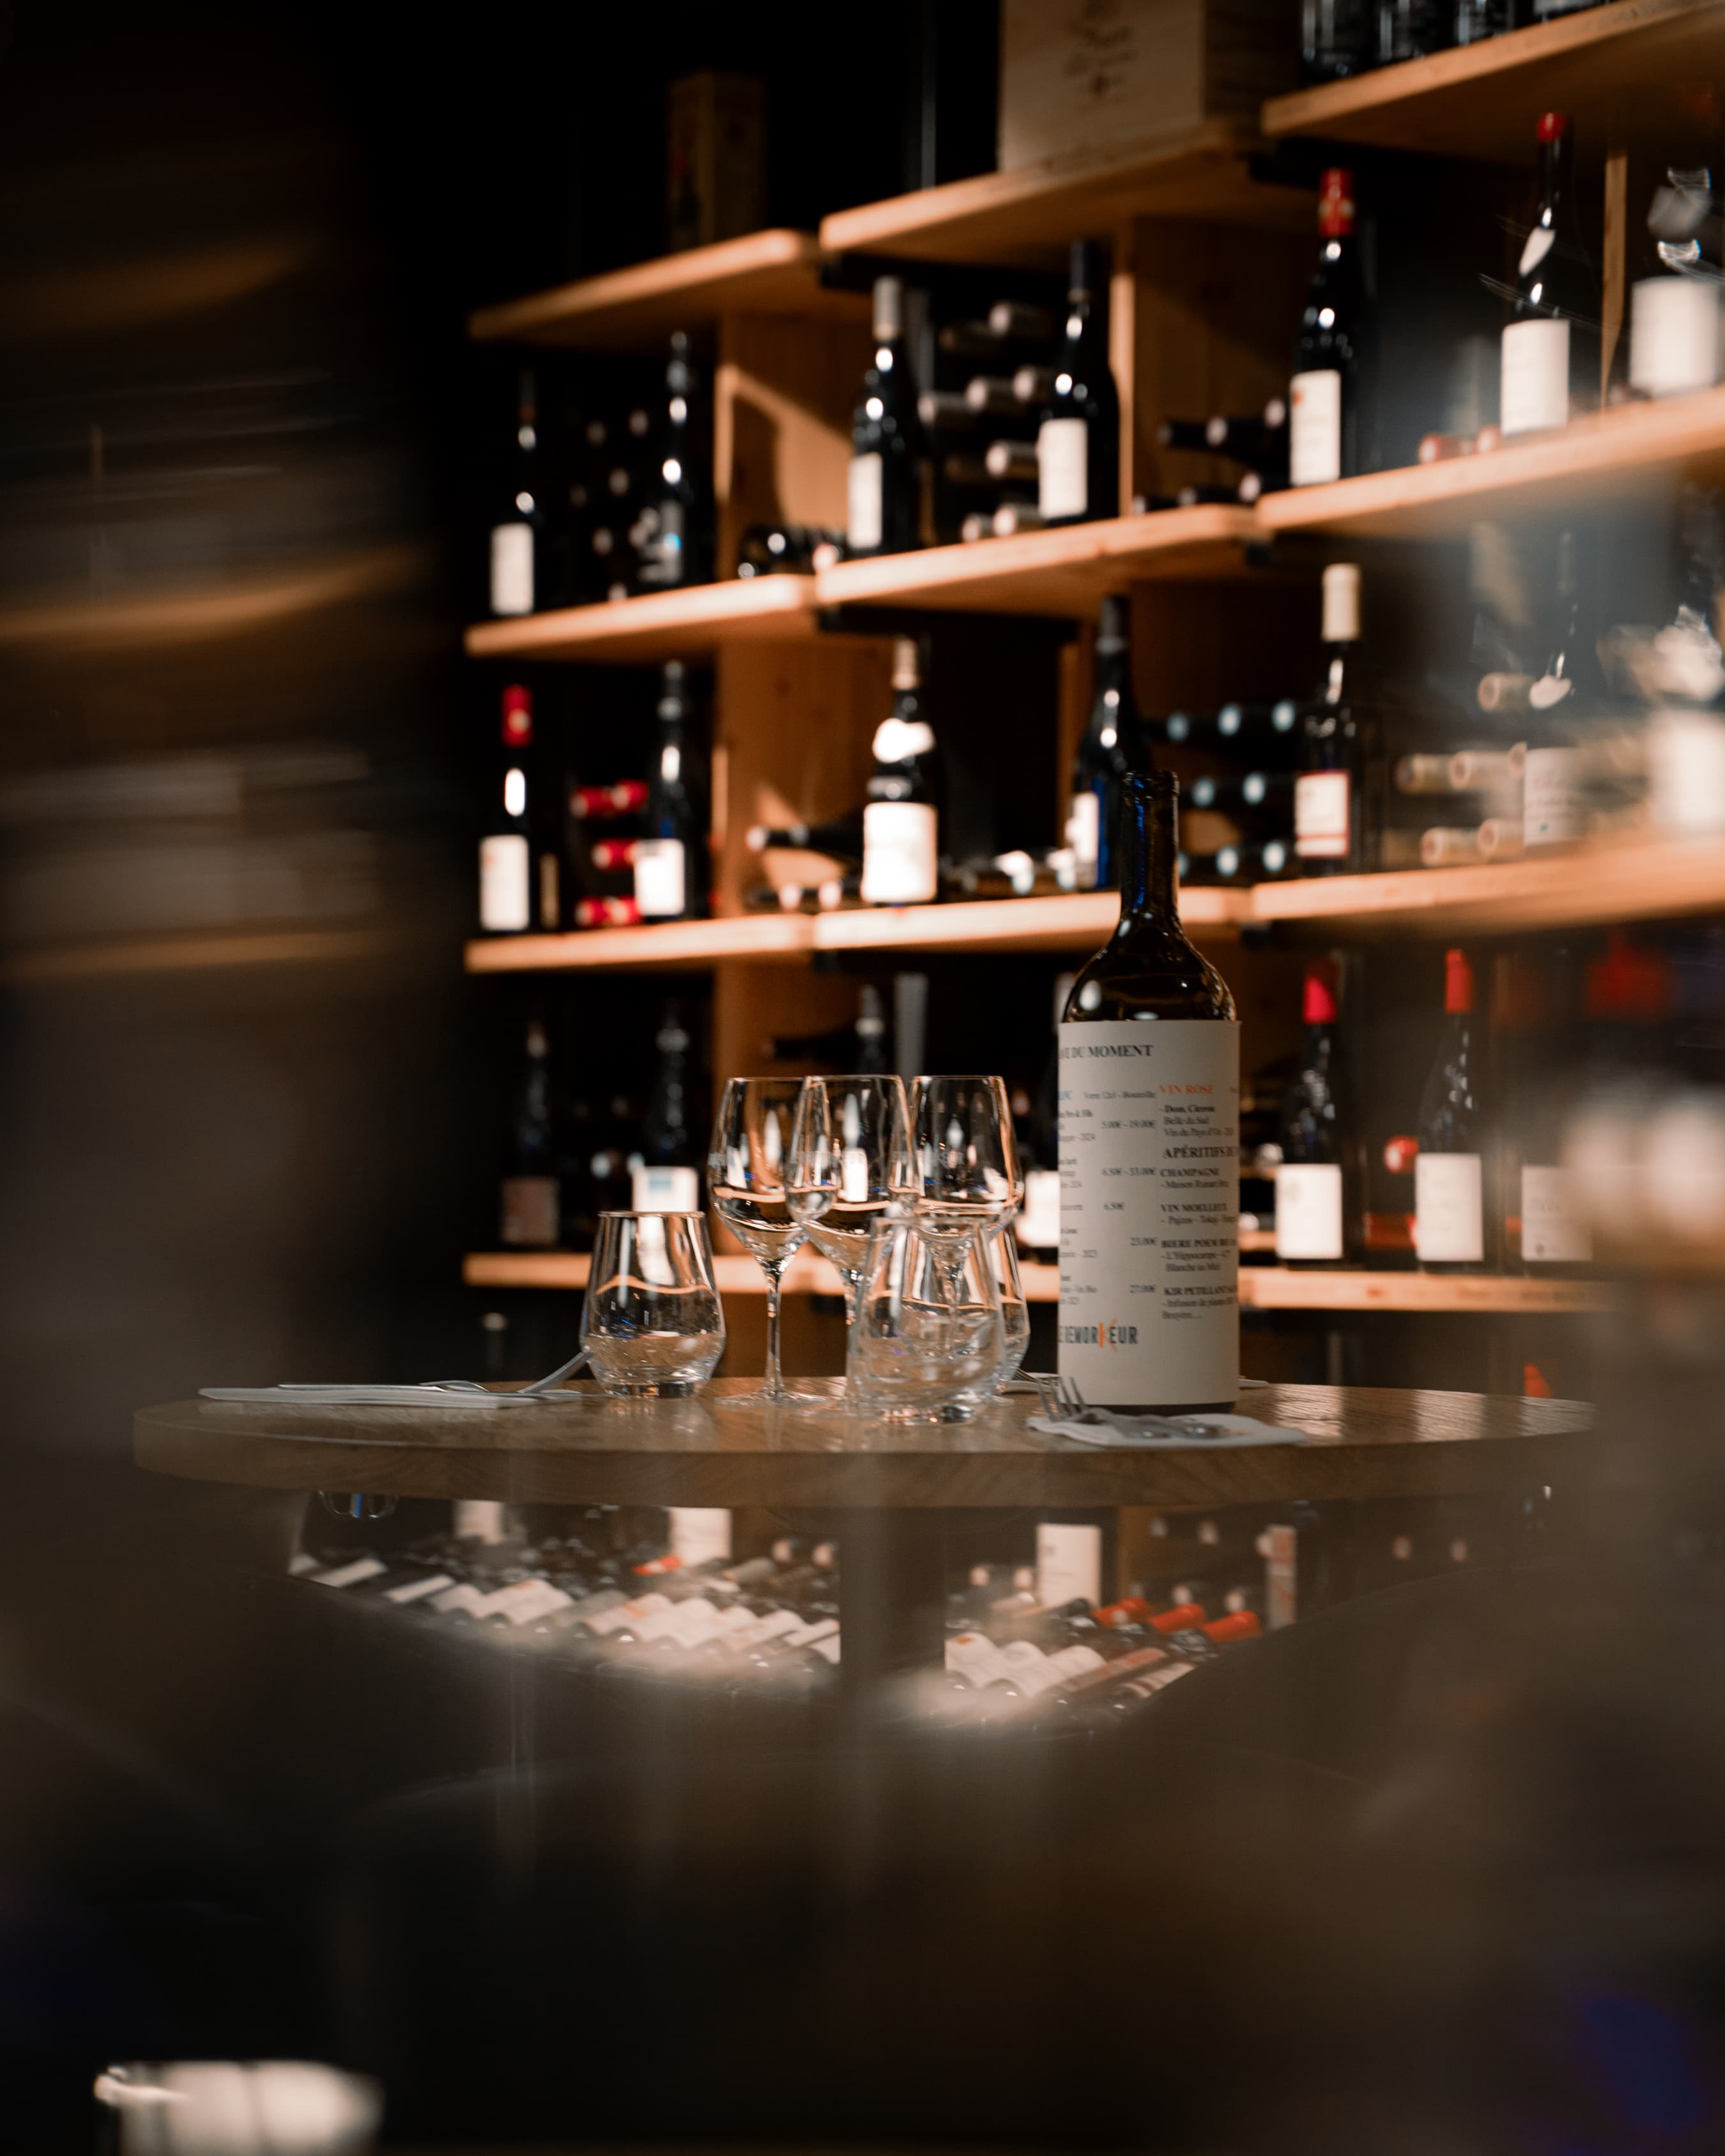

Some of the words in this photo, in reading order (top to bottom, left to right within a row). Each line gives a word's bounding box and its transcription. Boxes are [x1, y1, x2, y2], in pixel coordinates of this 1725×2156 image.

[1087, 1044, 1153, 1057] MOMENT
[1160, 1084, 1182, 1094] VIN
[1162, 1144, 1226, 1159] APÉRITIFS
[1160, 1168, 1220, 1177] CHAMPAGNE
[1160, 1204, 1179, 1212] VIN
[1181, 1203, 1228, 1212] MOELLEUX
[1164, 1287, 1183, 1296] KIR
